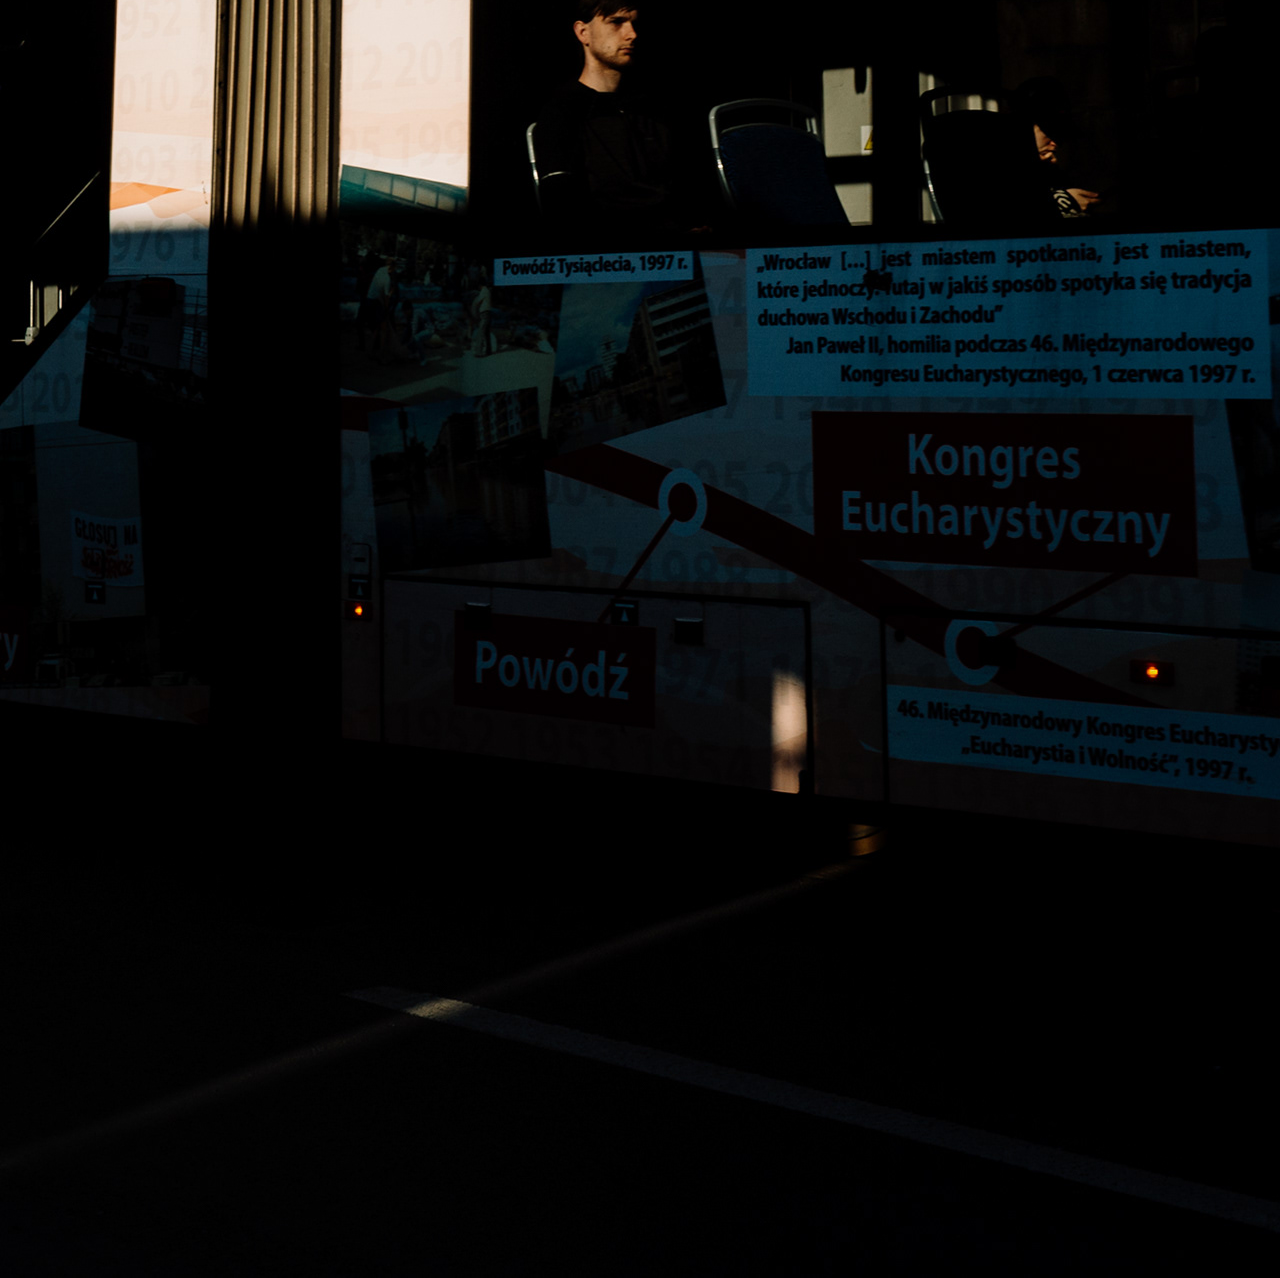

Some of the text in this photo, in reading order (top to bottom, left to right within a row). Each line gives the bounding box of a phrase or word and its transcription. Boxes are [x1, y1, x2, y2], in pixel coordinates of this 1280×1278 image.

[502, 254, 689, 278] Powódź Tysiąclecia, 1997 r.
[880, 250, 912, 272] jest
[921, 247, 997, 266] miastem
[1006, 243, 1103, 268] spotkania,
[1112, 241, 1150, 266] jest
[1160, 239, 1252, 259] miastem,
[757, 280, 800, 299] które
[928, 281, 945, 295] w
[945, 274, 989, 300] jakiś
[992, 272, 1058, 298] sposób
[1060, 271, 1136, 297] spotyka
[1140, 274, 1168, 295] się
[1170, 268, 1253, 294] tradycja
[757, 307, 830, 327] duchowa
[831, 305, 908, 327] Wschodu
[910, 305, 917, 325] i
[785, 336, 814, 355] Jan
[816, 335, 866, 354] Paweł
[887, 334, 952, 354] homilia
[954, 333, 1028, 358] podczas
[1029, 333, 1059, 353] 46.
[1062, 331, 1255, 358] Międzynarodowego
[840, 363, 1256, 388] Kongresu Eucharystycznego, 1 czerwca 1997 r.
[908, 433, 1081, 489] Kongres
[841, 490, 1171, 558] Eucharystyczny
[475, 640, 629, 701] Powódź
[897, 699, 925, 719] 46.
[927, 701, 1084, 738] Międzynarodowy
[1086, 715, 1166, 744] Kongres
[1078, 745, 1086, 765] i
[1185, 757, 1234, 780] 1997
[1238, 766, 1256, 785] r.
